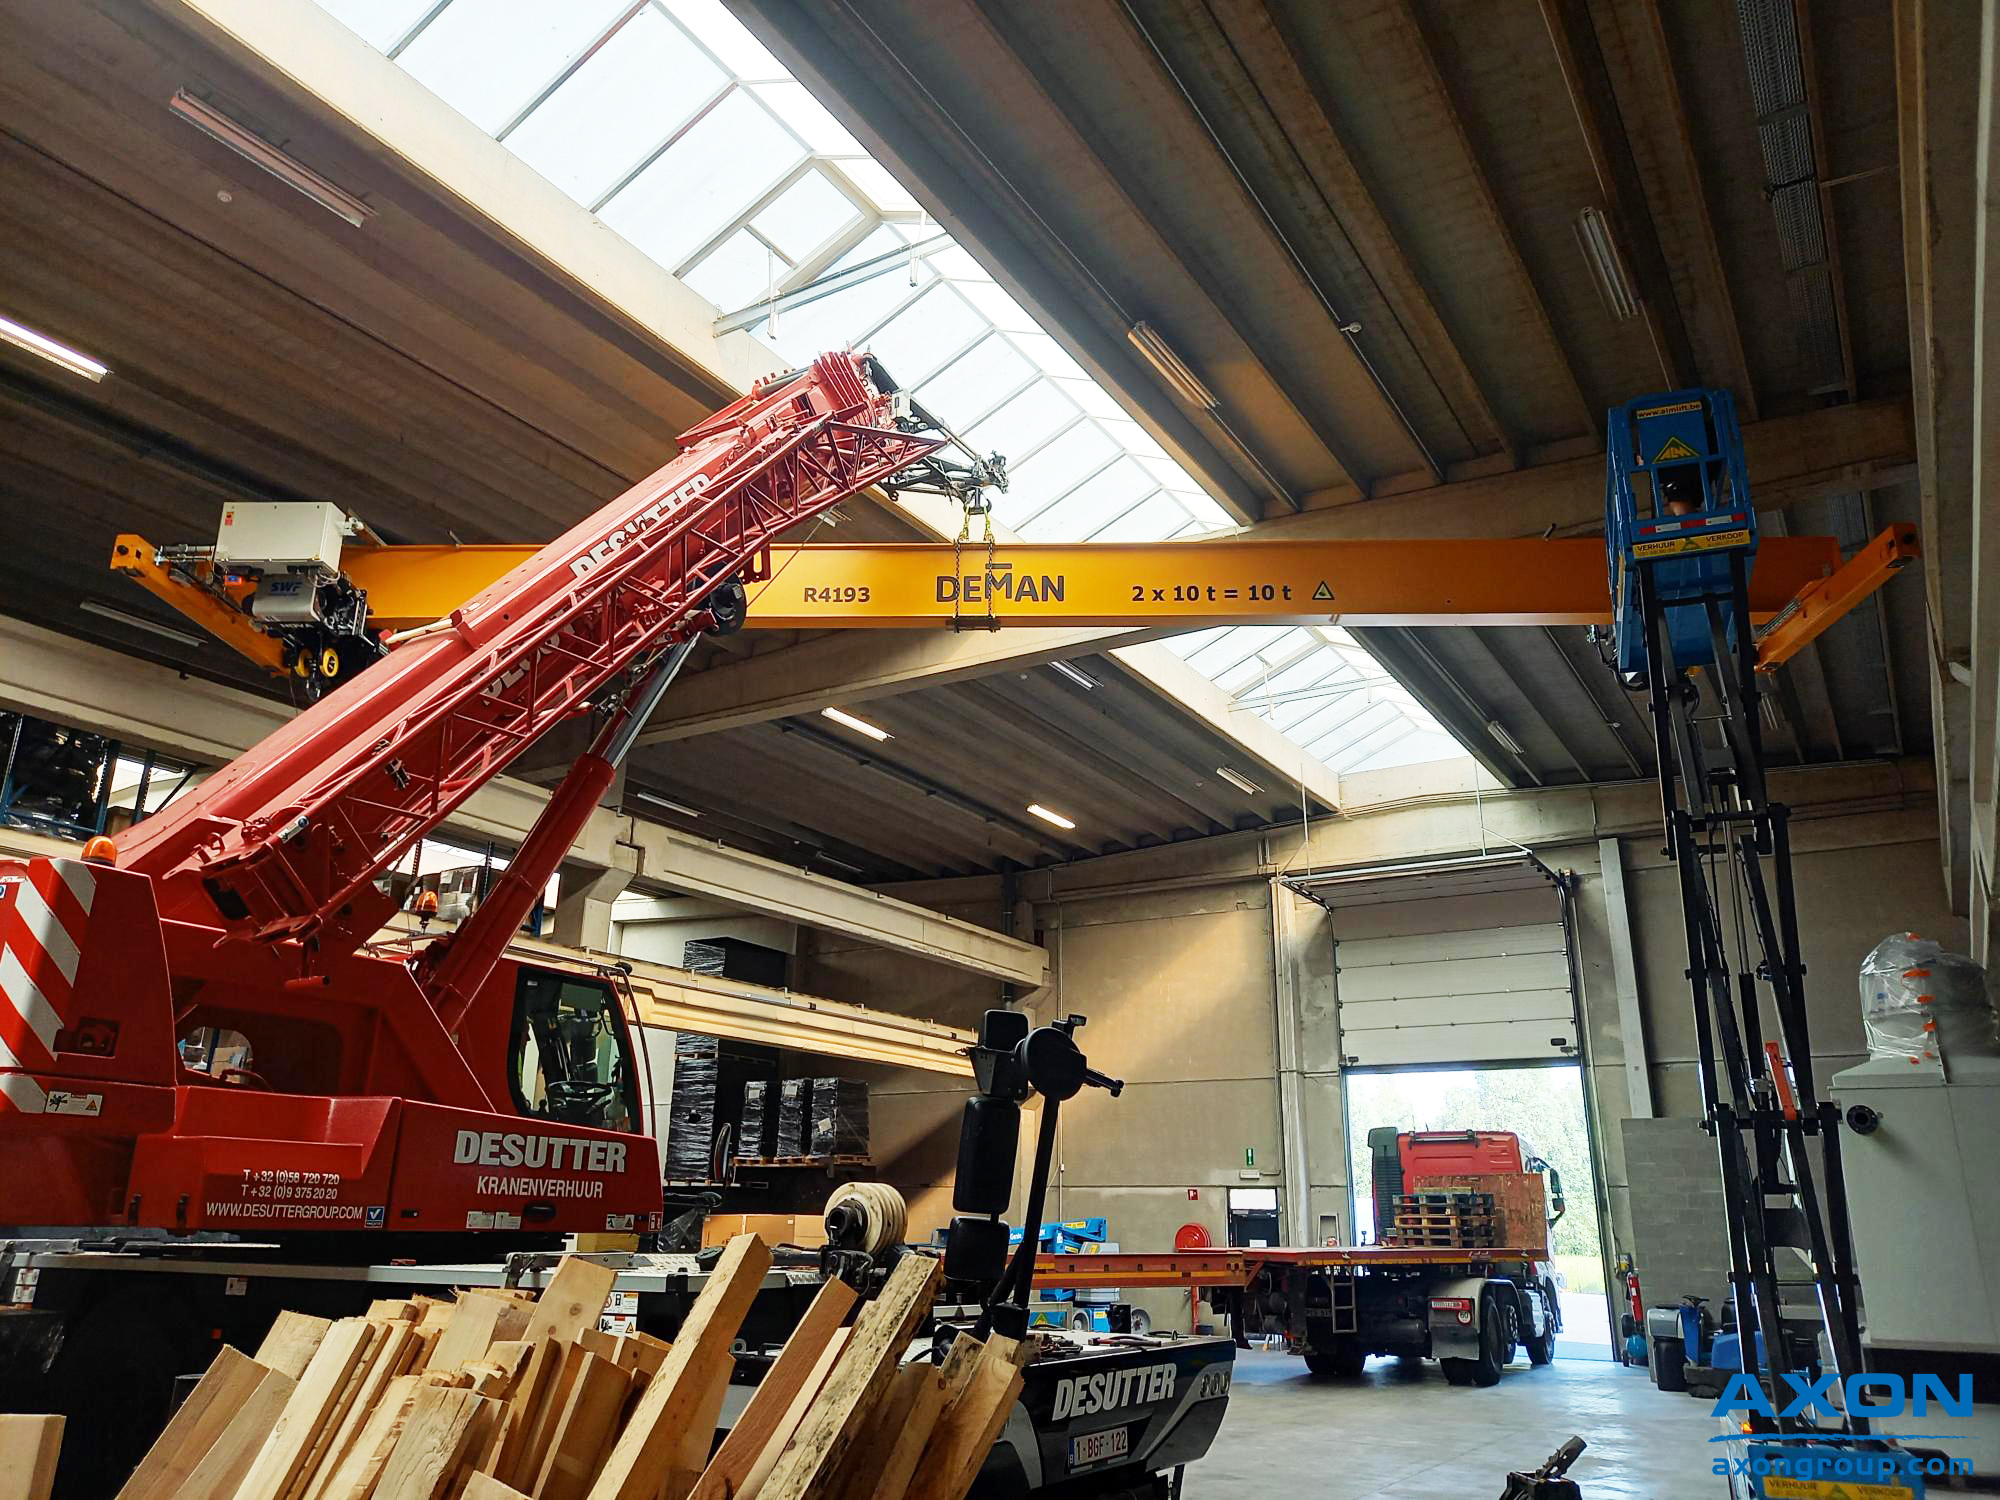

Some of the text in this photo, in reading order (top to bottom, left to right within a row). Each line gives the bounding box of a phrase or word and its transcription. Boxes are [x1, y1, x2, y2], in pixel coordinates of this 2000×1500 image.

[1637, 531, 1744, 551] VERHUUR VERKOOP
[804, 564, 1065, 603] R4193 DEMAN
[1132, 585, 1144, 602] 2
[1151, 589, 1165, 601] x
[1173, 585, 1200, 602] 10
[1207, 585, 1216, 602] t
[1248, 584, 1275, 601] 10
[1282, 584, 1292, 601] t
[453, 1130, 627, 1173] DESUTTER
[243, 1169, 251, 1181] T
[253, 1170, 273, 1182] +32
[303, 1172, 320, 1184] 720
[322, 1173, 339, 1185] 720
[477, 1176, 603, 1198] KRANENVERHUUR
[241, 1184, 249, 1196] T
[251, 1185, 271, 1197] +32
[274, 1184, 291, 1200] (0)9
[206, 1202, 363, 1219] WWW.DESUTTERGROUP.COM
[1052, 1362, 1177, 1421] DESUTTER
